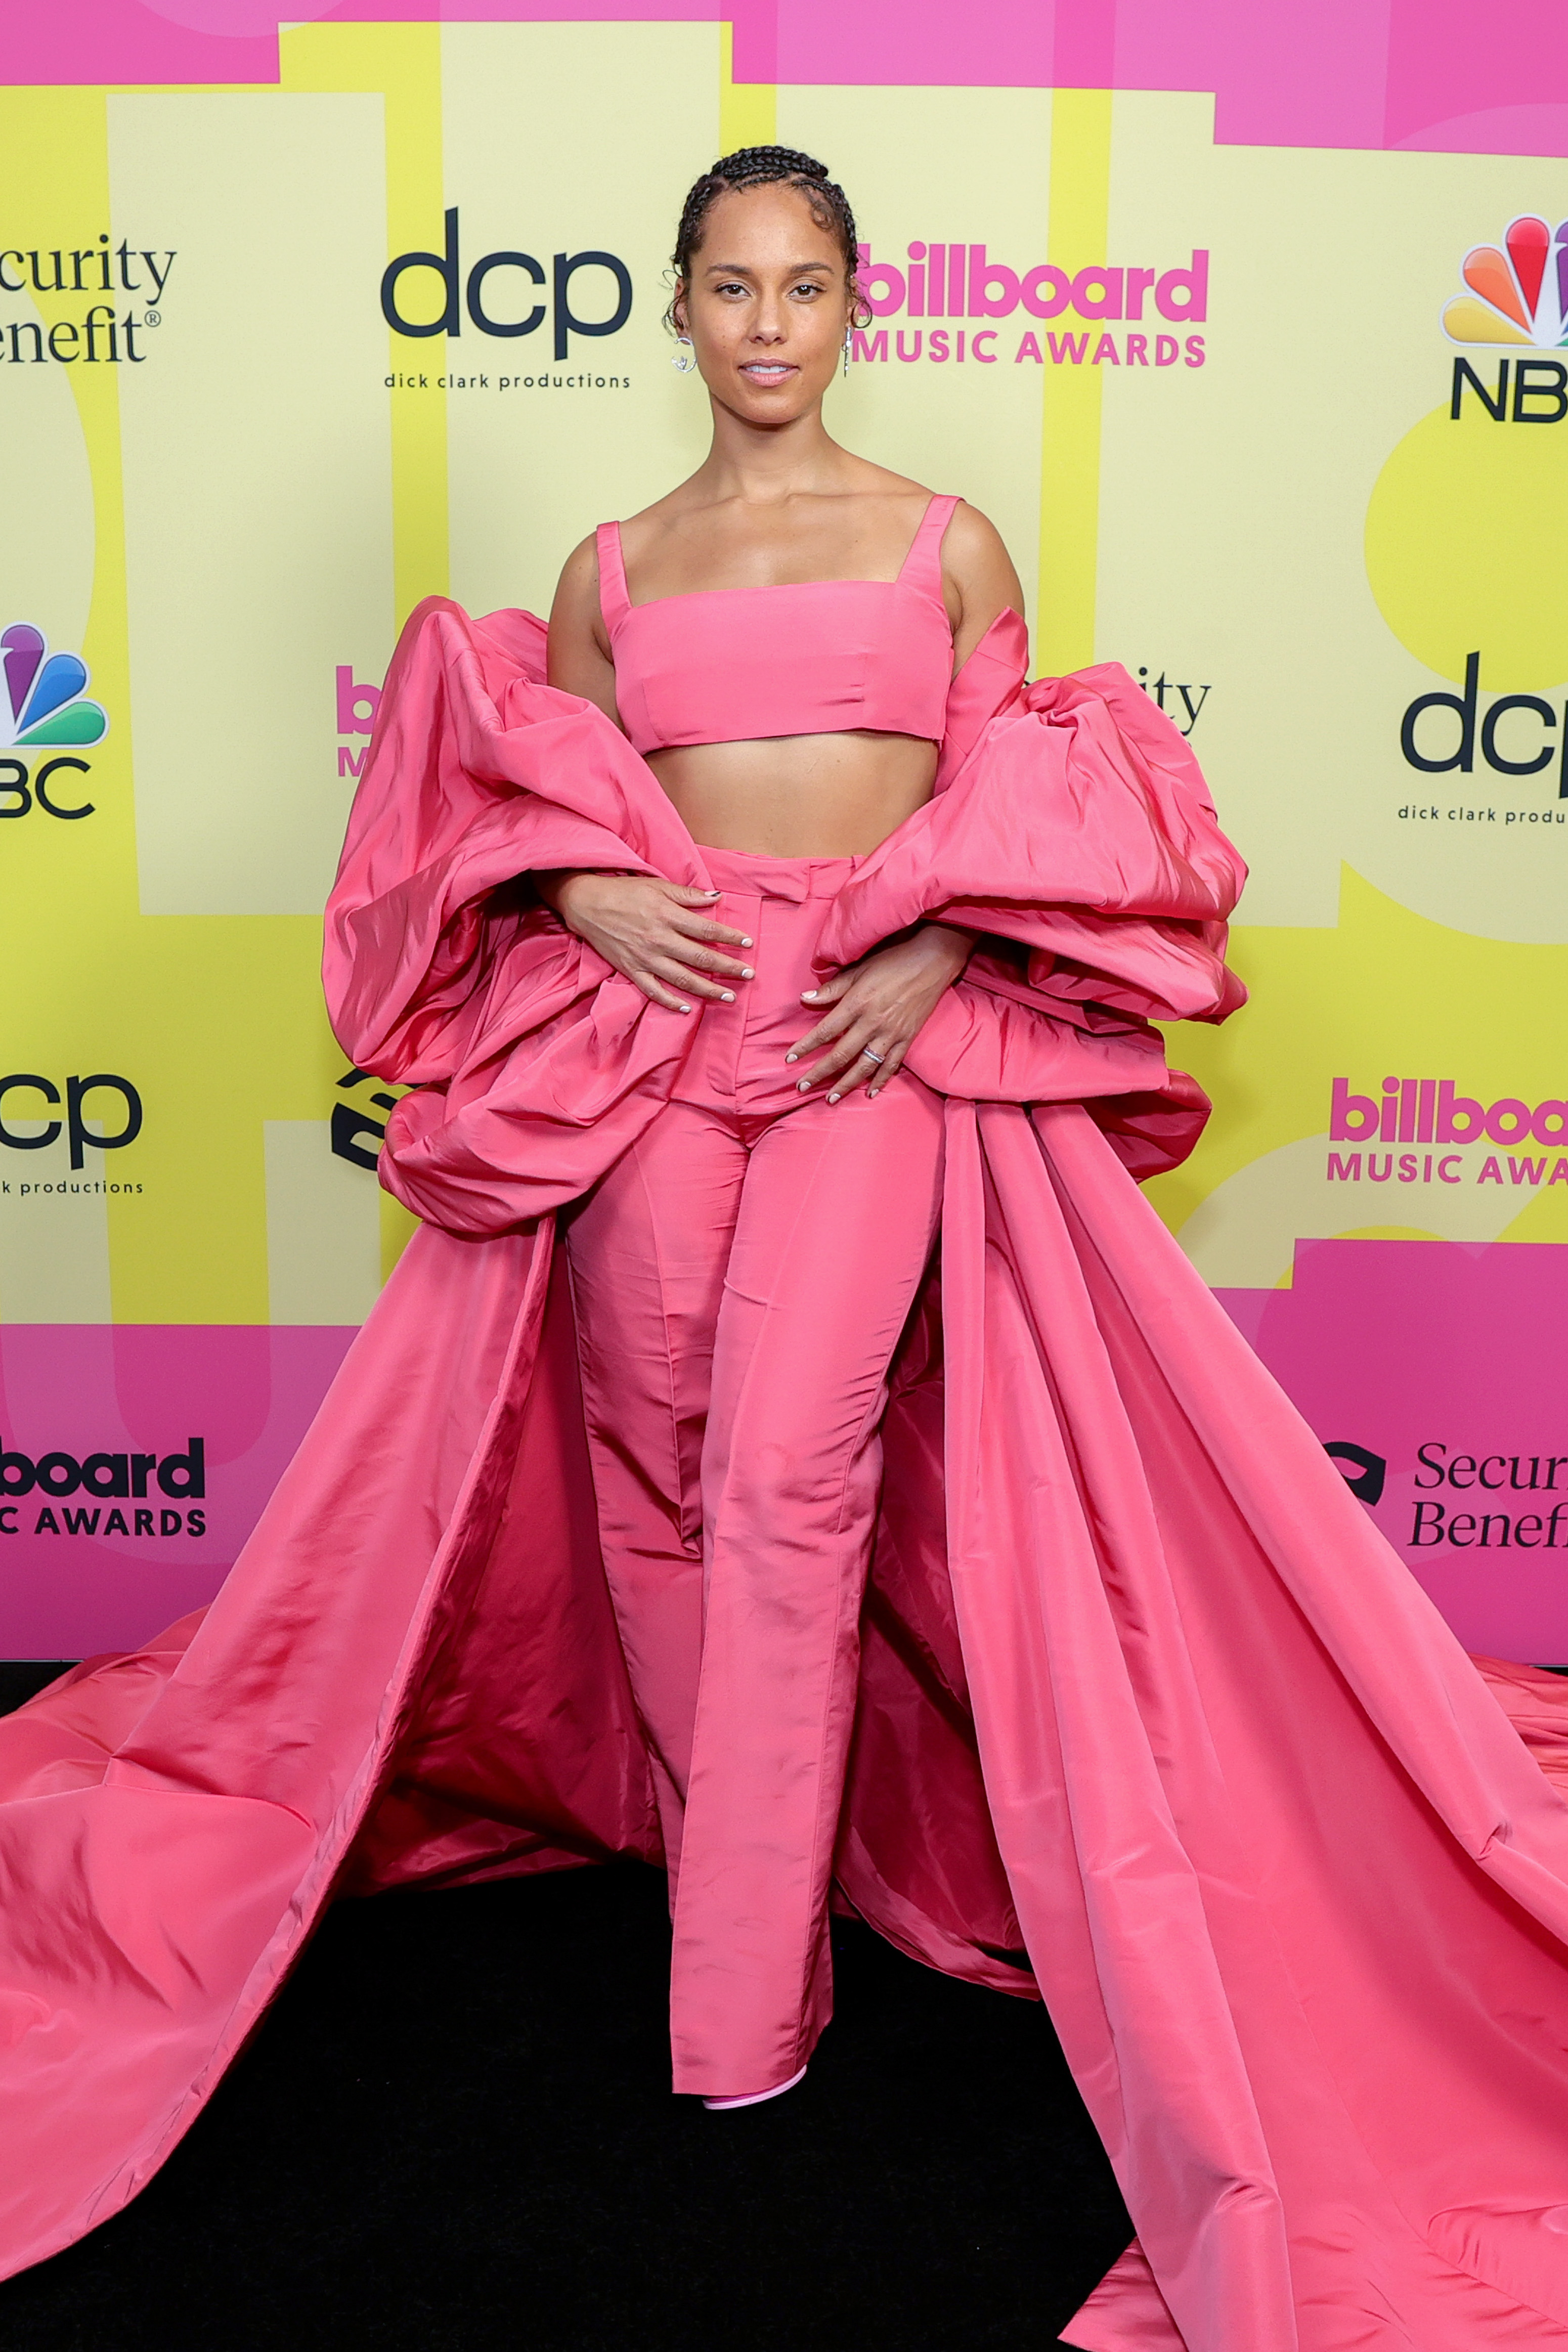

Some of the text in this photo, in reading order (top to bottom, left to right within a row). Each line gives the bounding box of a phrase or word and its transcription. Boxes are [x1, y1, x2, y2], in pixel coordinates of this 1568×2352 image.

[380, 206, 633, 361] dcp
[854, 241, 1209, 322] billboard
[852, 330, 1205, 368] MUSIC AWARDS
[384, 373, 630, 391] dick clark productions
[1450, 357, 1568, 423] NB
[1401, 650, 1568, 799] dc
[1398, 805, 1439, 819] dick
[1448, 807, 1496, 821] clark
[1327, 1153, 1462, 1183] MUSIC
[21, 1181, 143, 1196] productions
[34, 1507, 206, 1537] AWARDS
